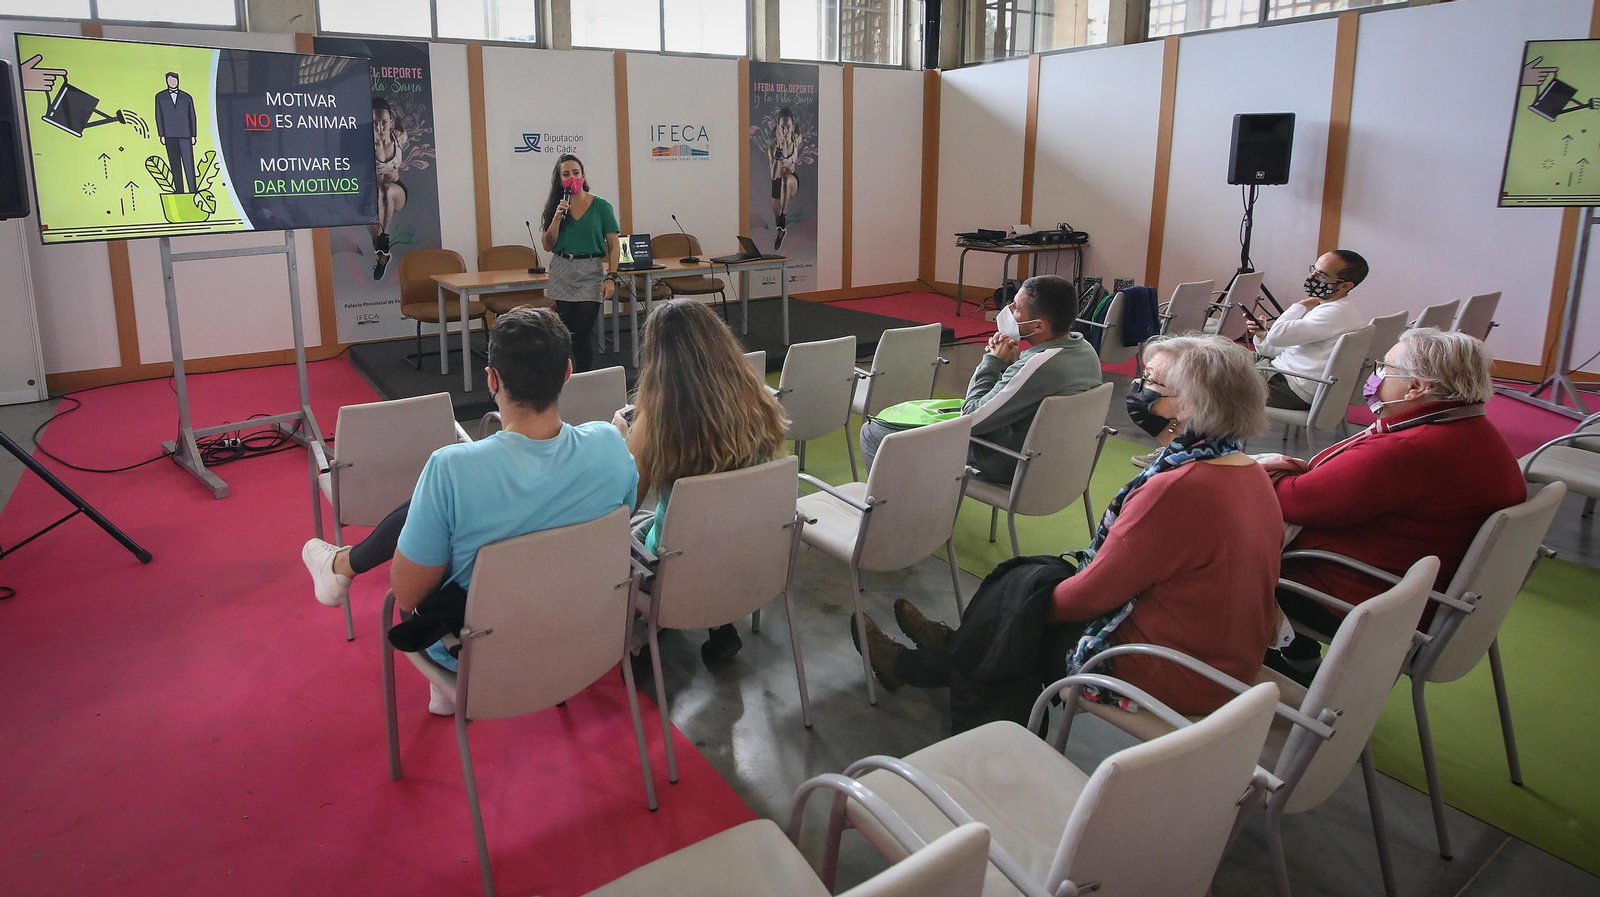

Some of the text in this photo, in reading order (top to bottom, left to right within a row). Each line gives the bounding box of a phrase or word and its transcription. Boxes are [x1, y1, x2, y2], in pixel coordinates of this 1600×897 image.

[381, 66, 422, 79] DEPORTE
[391, 77, 424, 93] Sana
[758, 82, 774, 92] FERIA
[776, 83, 787, 93] DEL
[789, 84, 814, 94] DEPORTE
[266, 92, 337, 108] MOTIVAR
[245, 113, 358, 130] NO ES ANIMAR
[544, 133, 584, 145] Diputación
[650, 125, 709, 142] IFECA
[544, 143, 577, 154] de Cádiz
[260, 157, 350, 172] MOTIVAR ES
[254, 177, 359, 194] DAR MOTIVOS
[357, 313, 379, 321] IFECA
